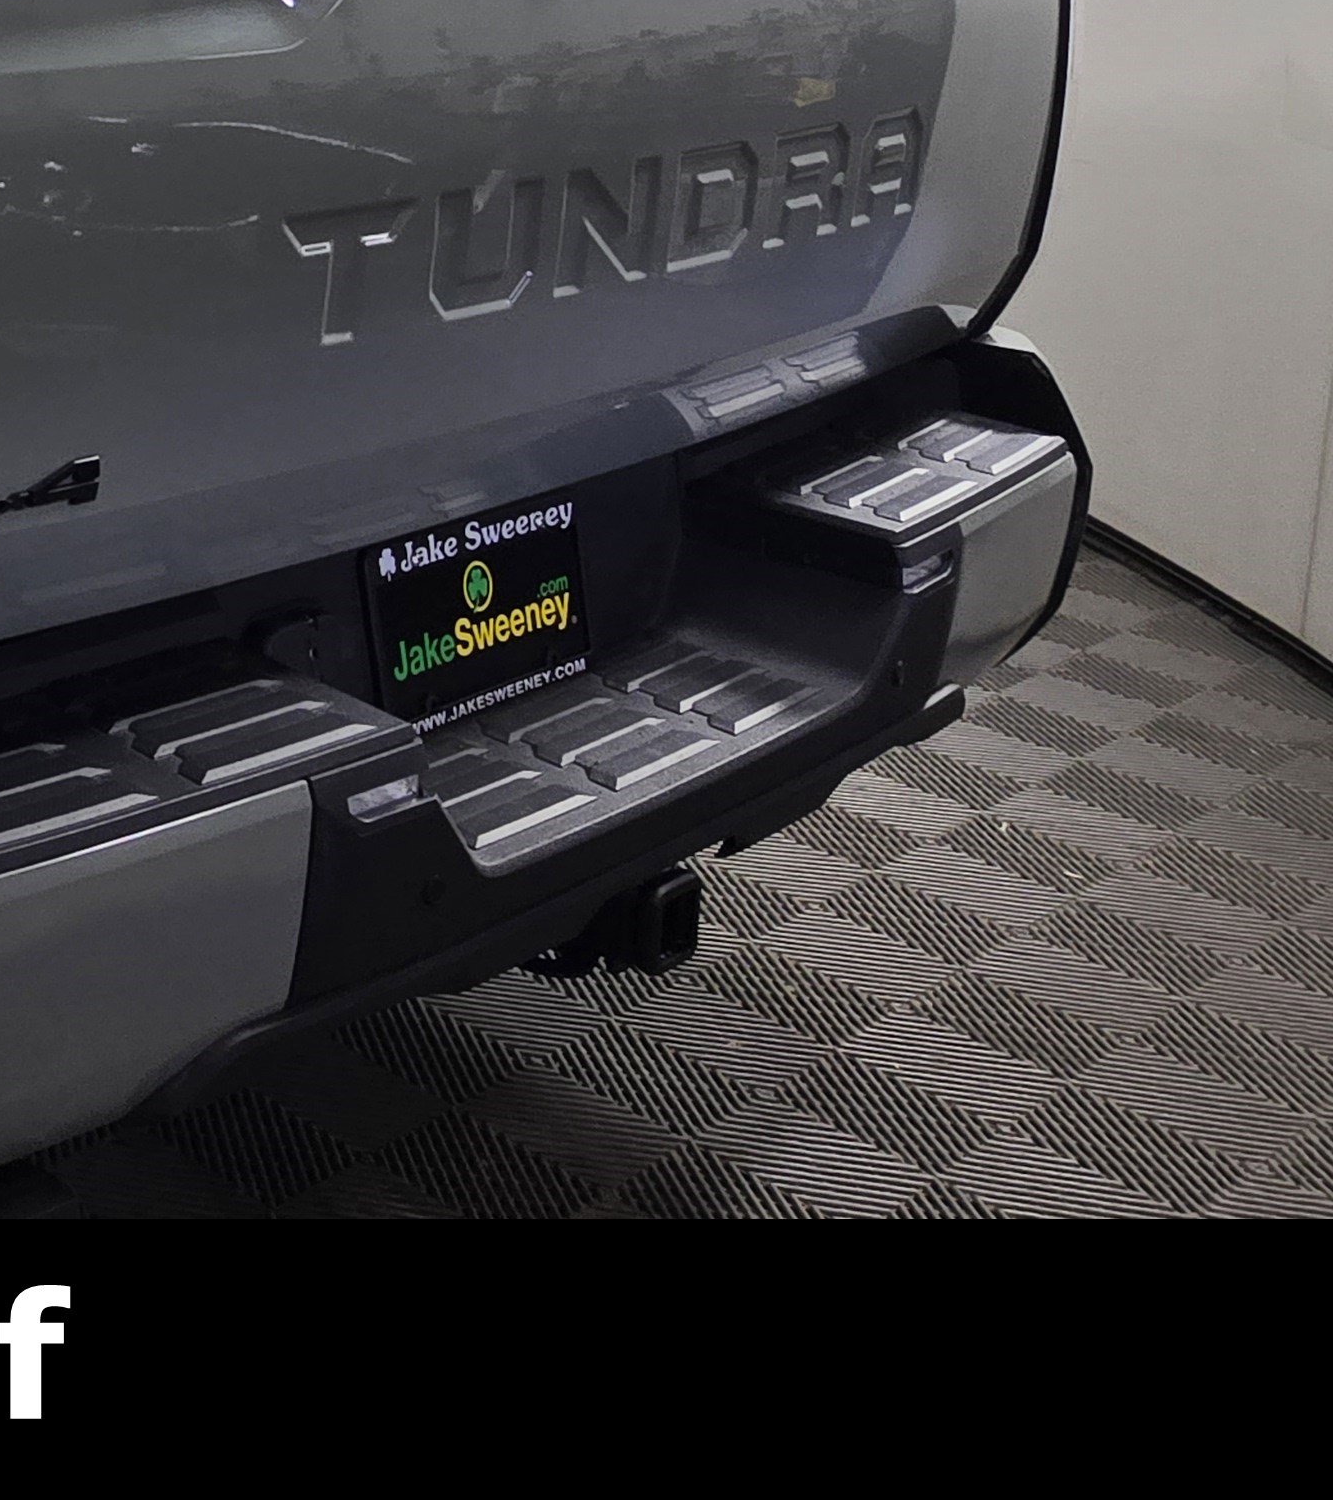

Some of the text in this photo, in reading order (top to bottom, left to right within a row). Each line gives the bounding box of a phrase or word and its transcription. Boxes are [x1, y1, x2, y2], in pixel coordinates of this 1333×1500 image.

[282, 108, 924, 345] TUNDRA
[400, 501, 573, 573] Jake Sweeney
[536, 575, 569, 598] .com
